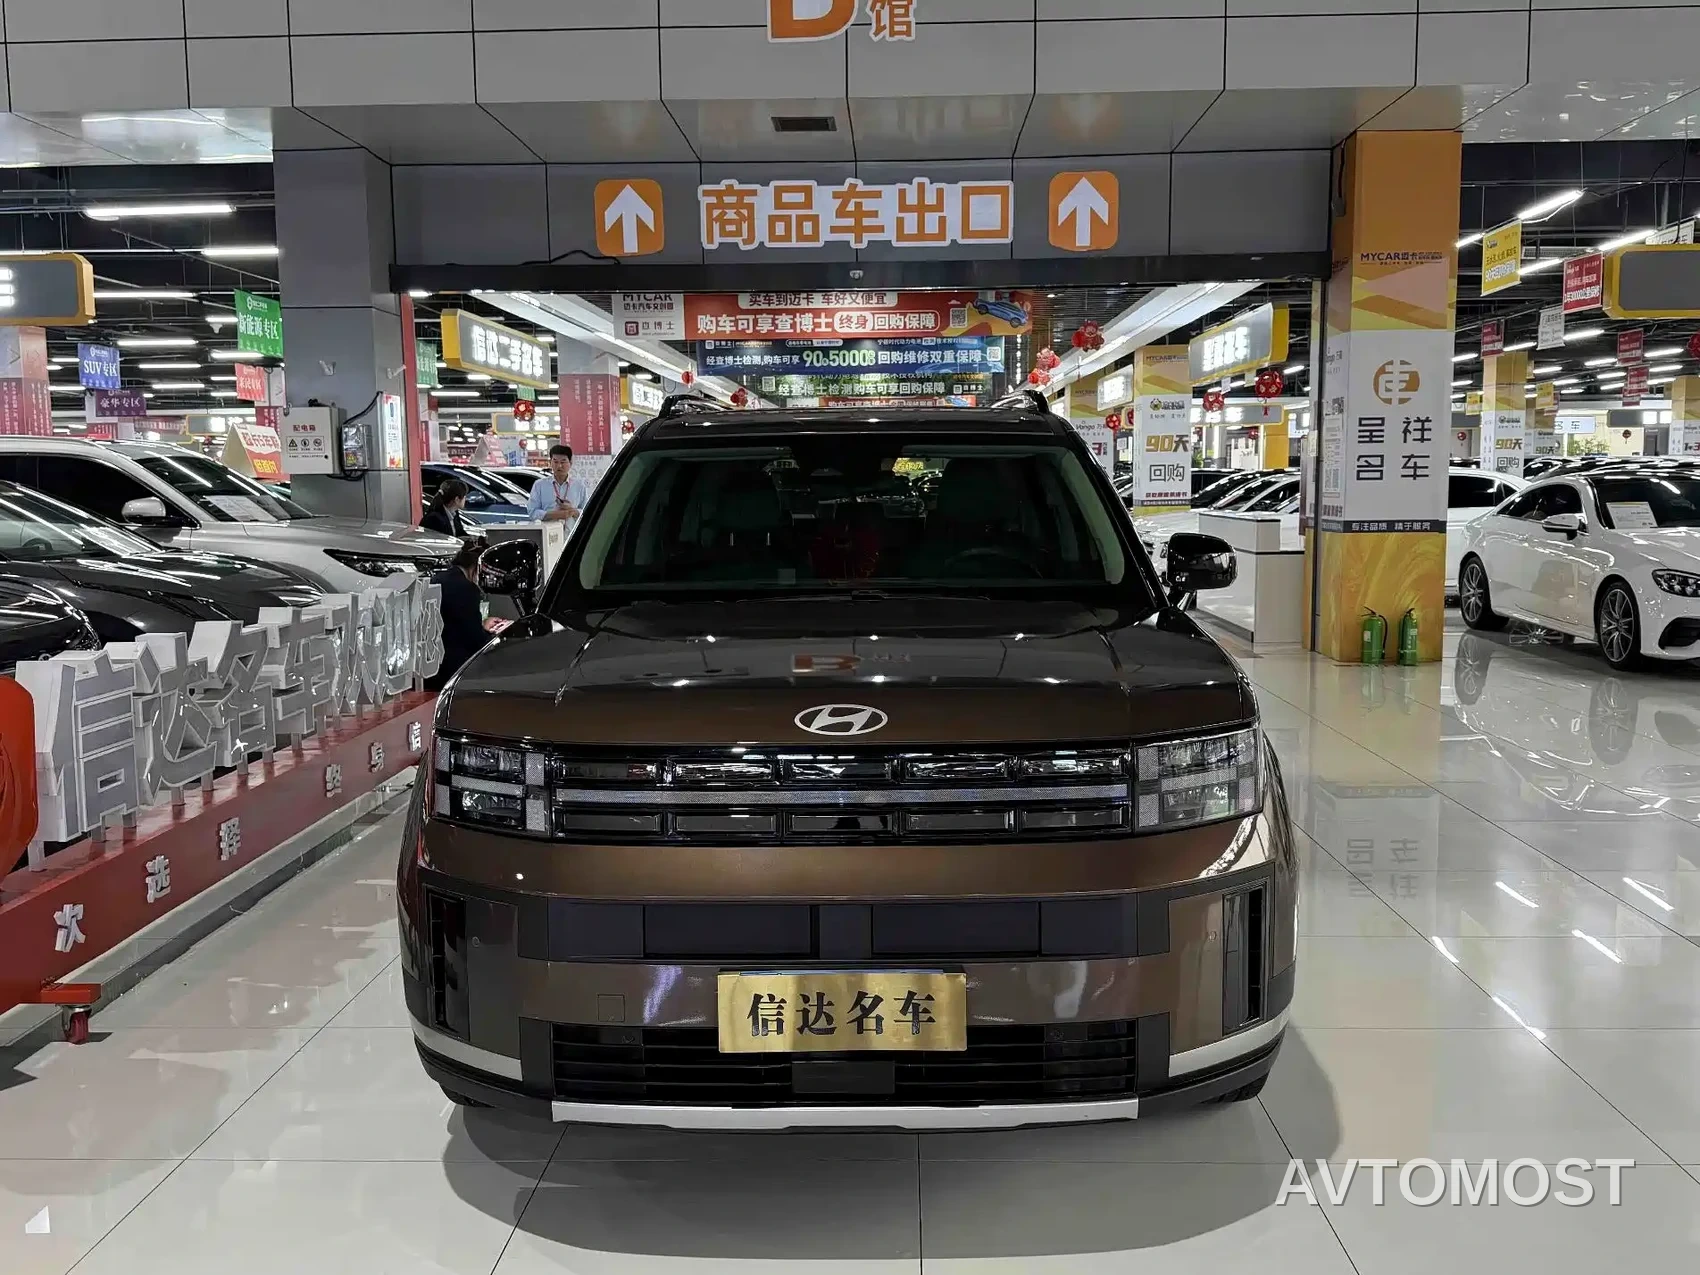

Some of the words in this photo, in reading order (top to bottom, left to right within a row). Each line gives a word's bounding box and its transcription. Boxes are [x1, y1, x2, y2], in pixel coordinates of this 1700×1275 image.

[699, 179, 1013, 249] 商品车出口
[292, 424, 316, 432] 配电箱
[1144, 434, 1190, 453] 90天
[1495, 438, 1523, 451] 90天
[1149, 464, 1186, 484] 回购
[747, 990, 937, 1037] 信达名车
